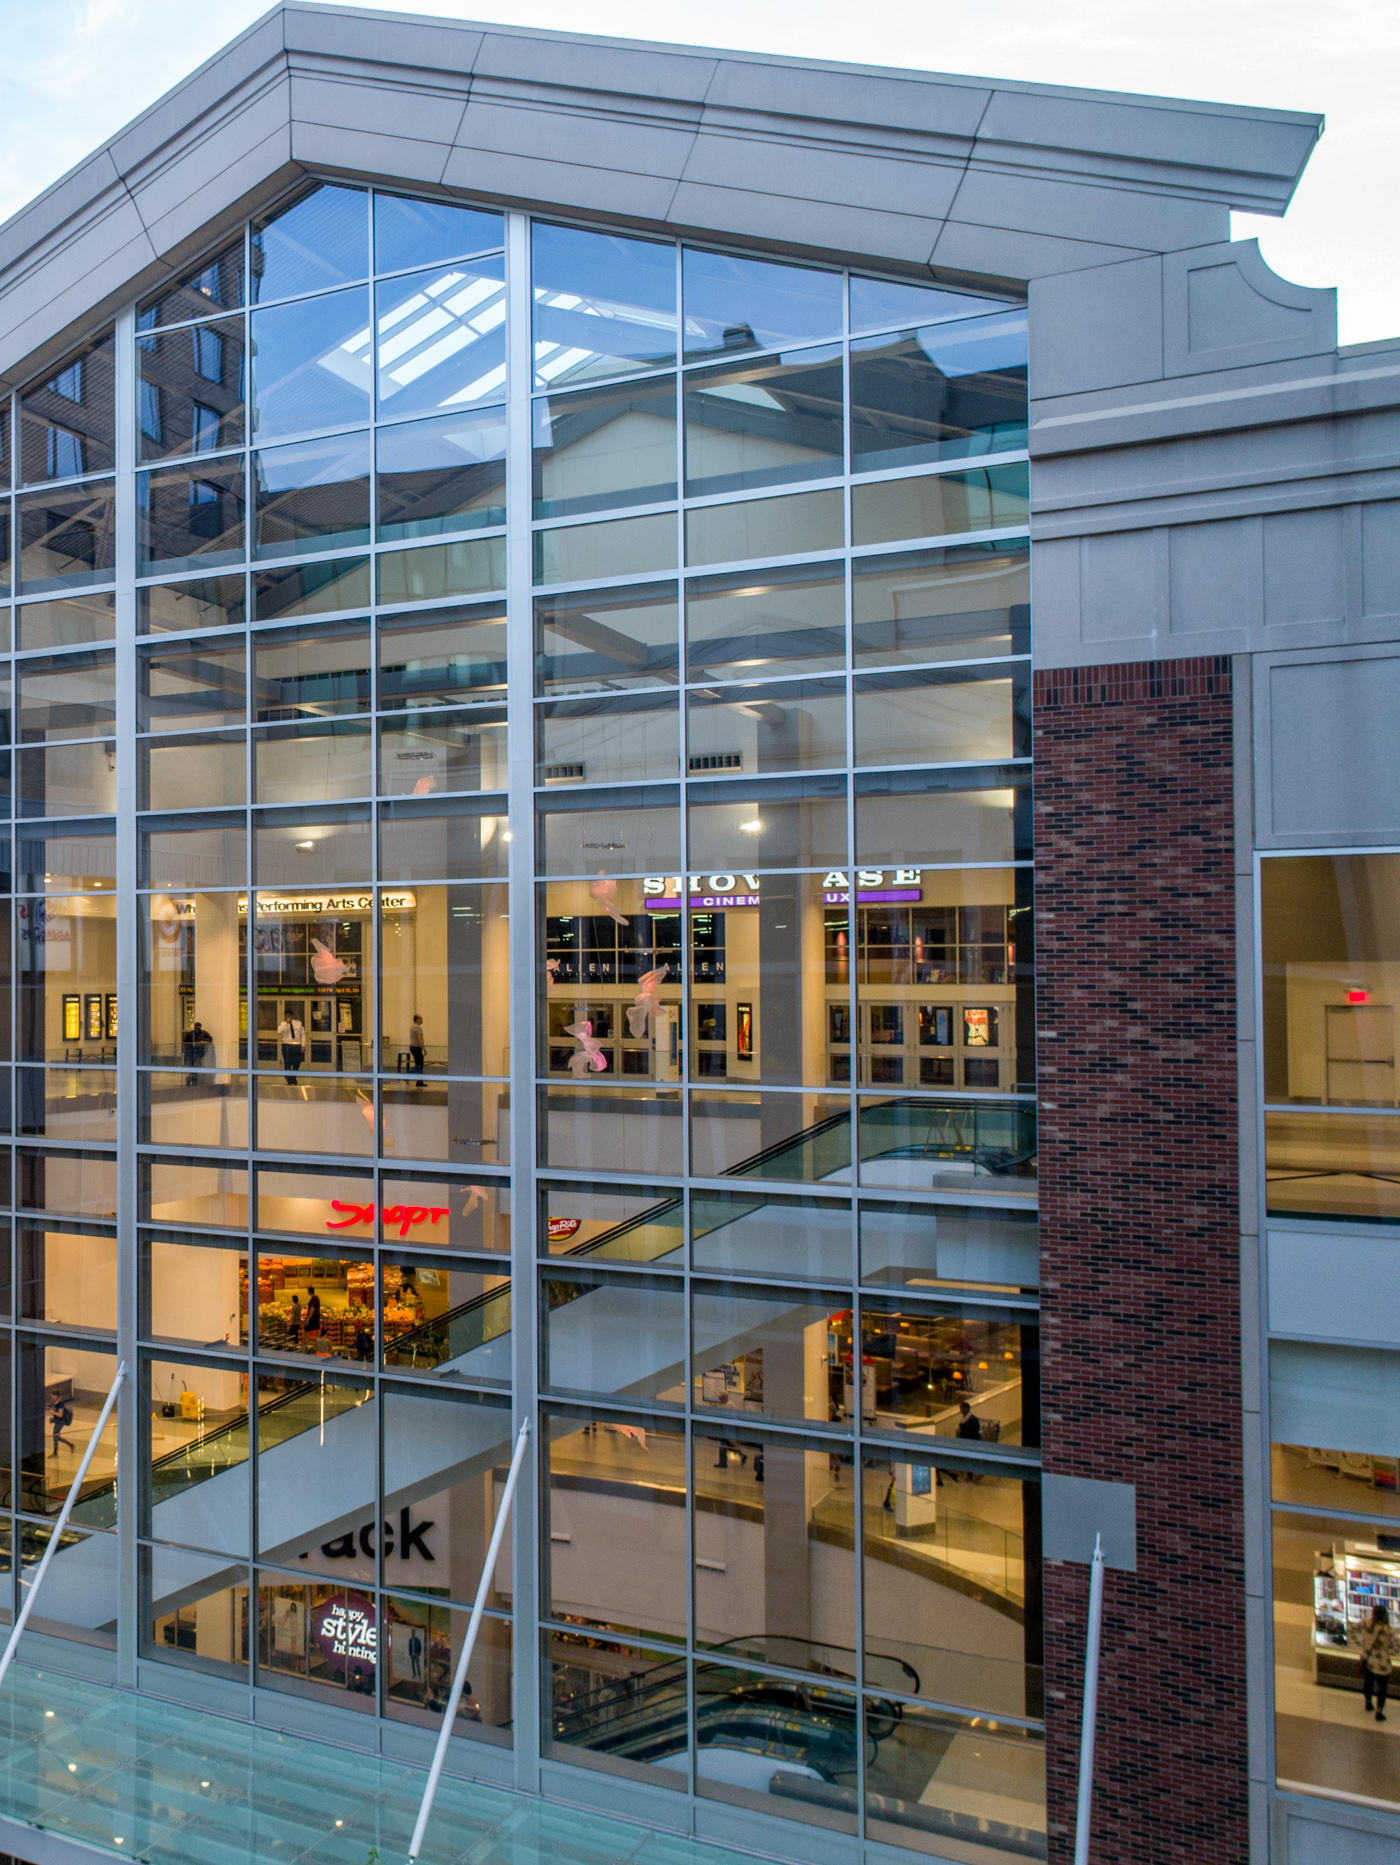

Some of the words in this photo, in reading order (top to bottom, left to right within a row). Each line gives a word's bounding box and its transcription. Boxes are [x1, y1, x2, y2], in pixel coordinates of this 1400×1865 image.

[255, 900, 323, 913] Performing
[326, 898, 355, 910] Arts
[358, 895, 406, 908] Ceter
[703, 896, 760, 906] CINEM
[826, 893, 850, 903] UX
[553, 963, 610, 972] ALEN
[663, 962, 725, 972] ALEN
[299, 1506, 435, 1560] ack
[321, 1617, 377, 1648] style
